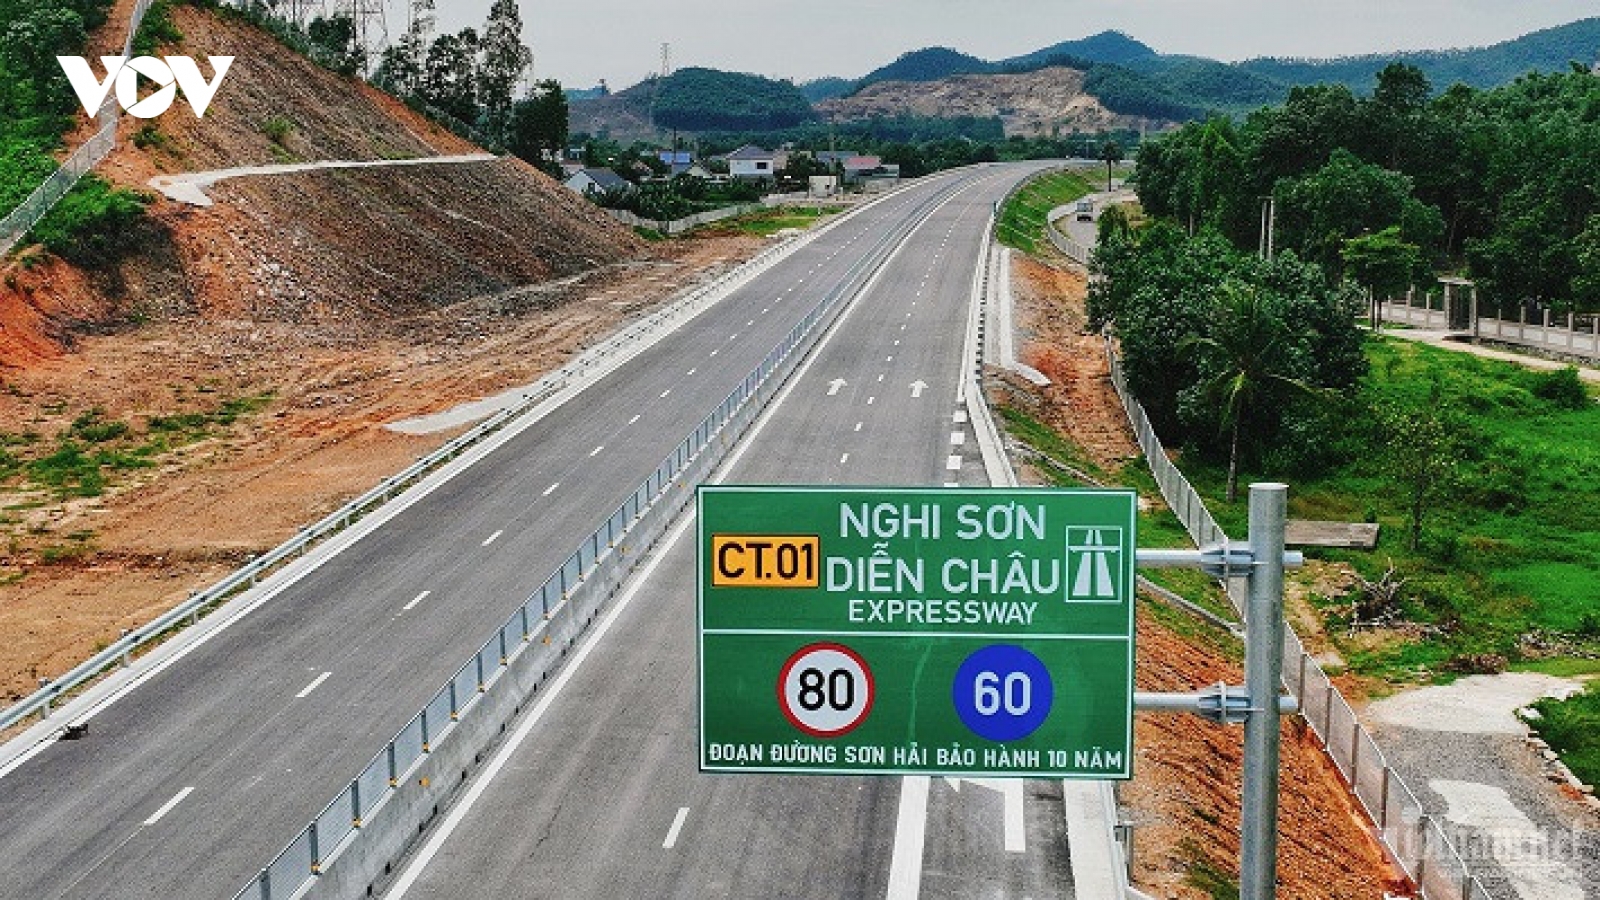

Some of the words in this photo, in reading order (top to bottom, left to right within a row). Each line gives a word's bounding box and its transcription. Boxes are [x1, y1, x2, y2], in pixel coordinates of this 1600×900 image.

[840, 502, 941, 539] NGHI
[956, 501, 1045, 540] SƠN
[718, 542, 814, 581] CT.01
[826, 541, 924, 592] DIỄN
[942, 550, 1060, 594] CHÂU
[849, 600, 1037, 625] EXPRESSWAY
[798, 667, 855, 711] 80
[974, 671, 1031, 716] 60
[708, 743, 763, 766] ĐOẠN
[769, 740, 837, 763] ĐƯỜNG
[844, 745, 885, 764] SƠN
[894, 742, 927, 766] HẢI
[936, 742, 976, 766] BẢO
[984, 744, 1040, 768] HÀNH
[1048, 750, 1067, 768] 10
[1074, 746, 1122, 770] NĂM
